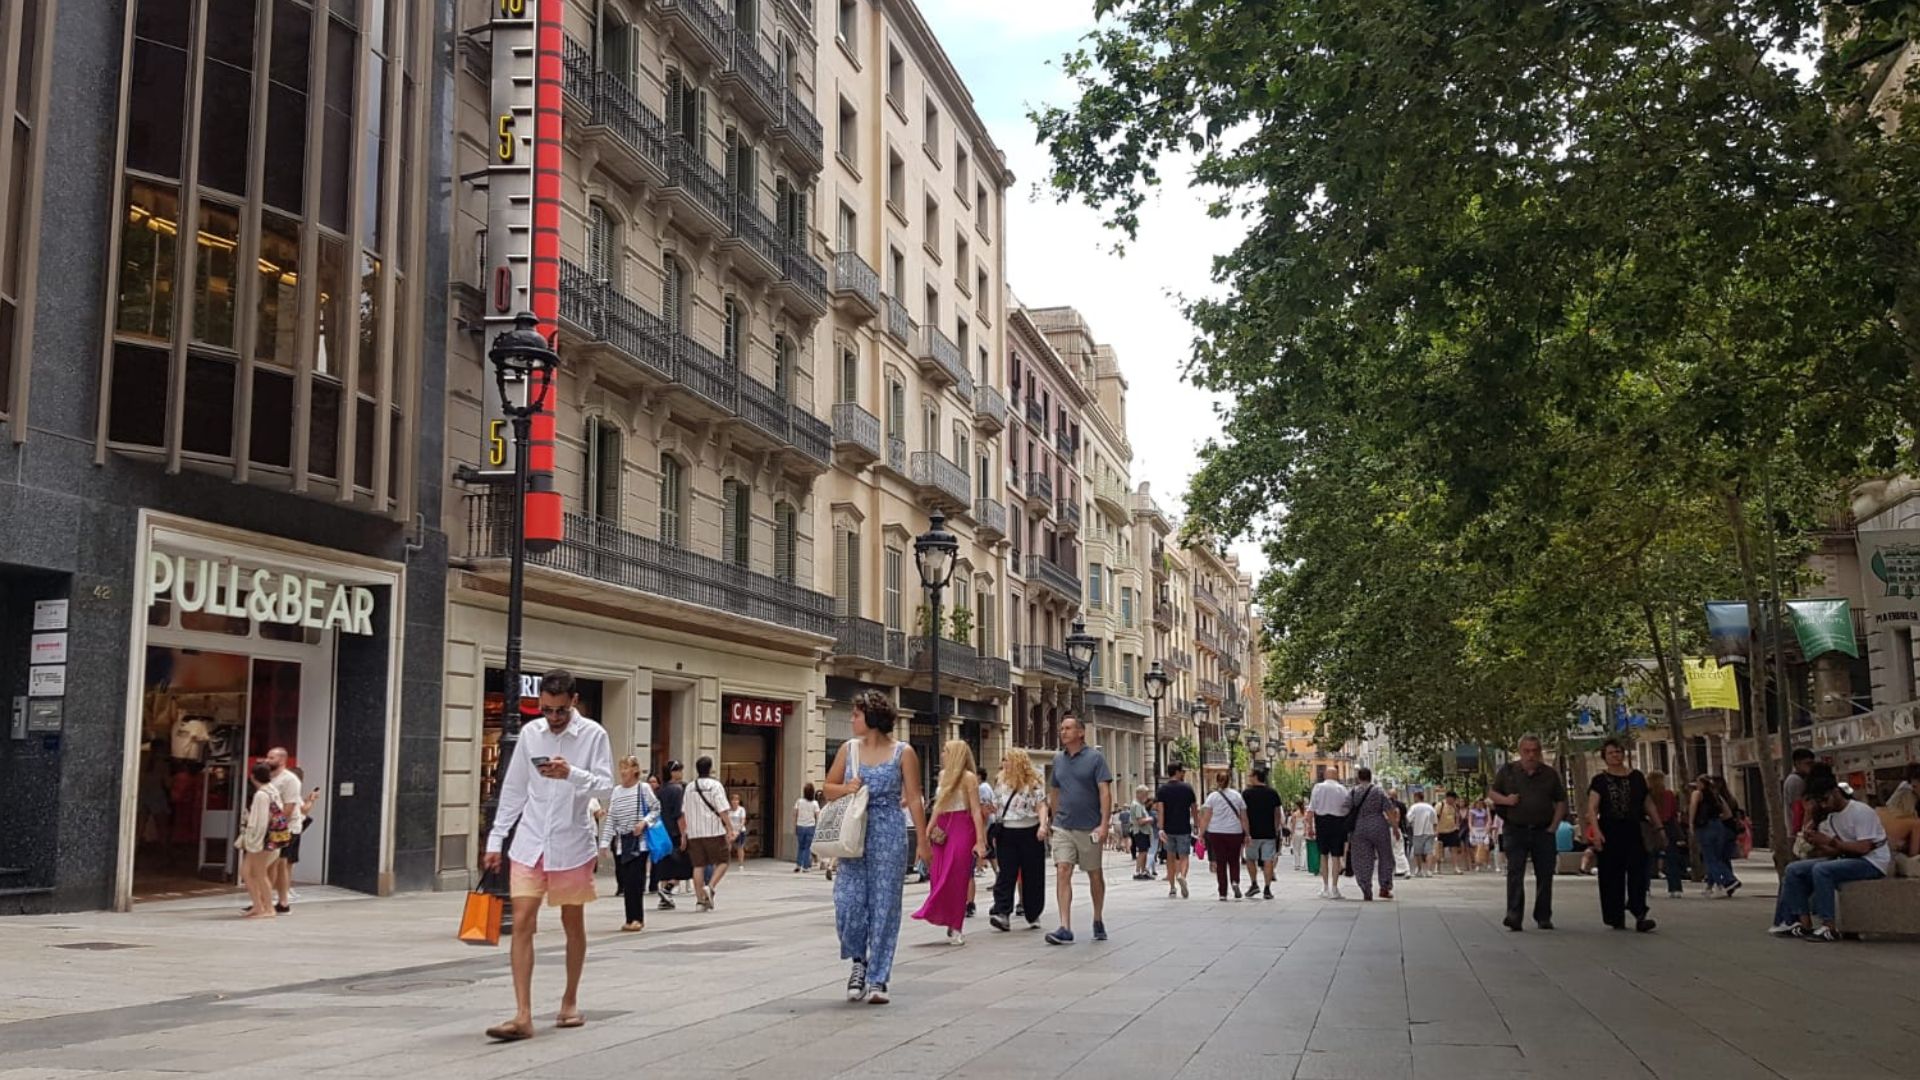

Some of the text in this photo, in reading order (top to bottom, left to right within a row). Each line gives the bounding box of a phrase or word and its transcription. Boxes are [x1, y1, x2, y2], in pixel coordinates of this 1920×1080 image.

[498, 115, 514, 161] 5
[495, 266, 511, 312] 0
[489, 420, 505, 465] 5
[93, 585, 112, 599] 42
[147, 552, 375, 636] PULL&BEAR
[733, 702, 782, 723] CASAS
